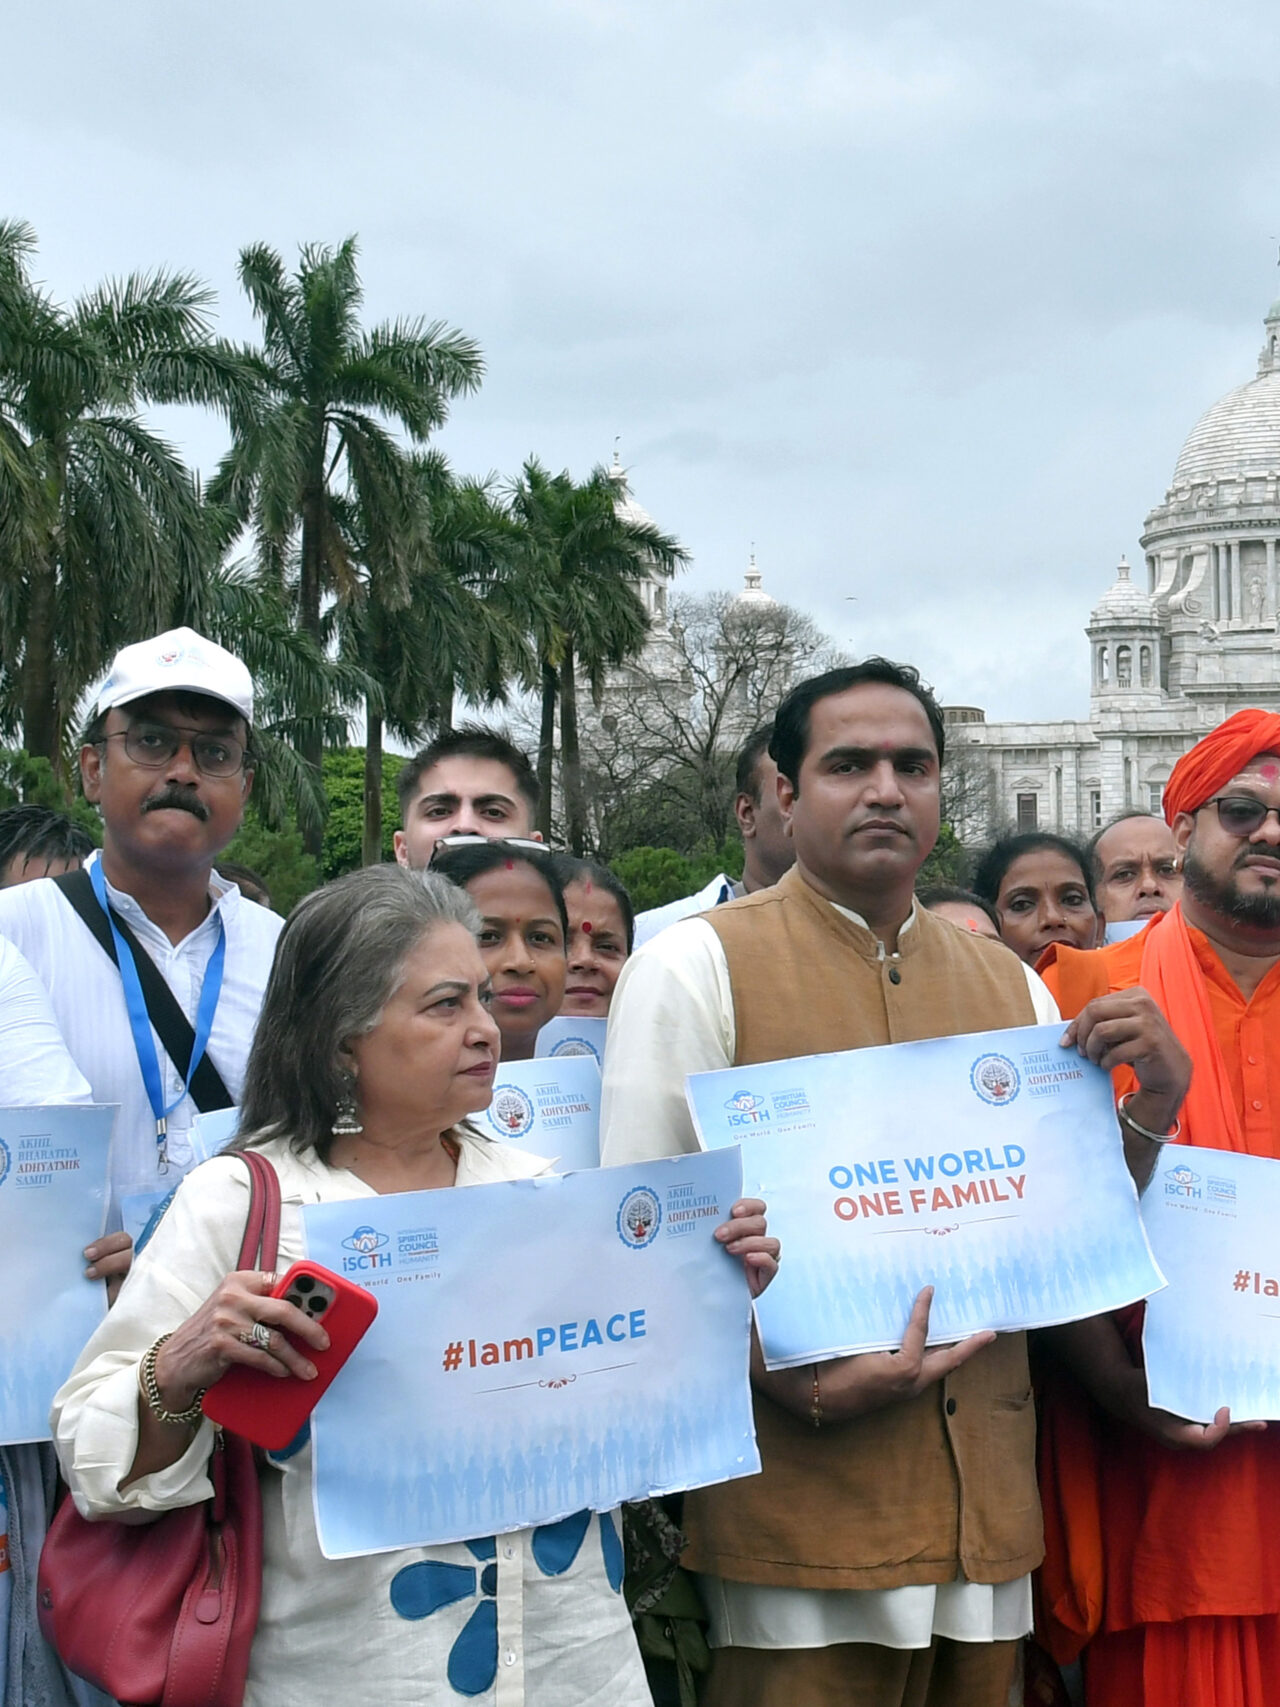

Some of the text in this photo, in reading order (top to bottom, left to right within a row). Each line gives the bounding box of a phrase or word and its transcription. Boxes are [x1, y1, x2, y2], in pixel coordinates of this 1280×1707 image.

[1022, 1053, 1052, 1065] AKHIL
[1024, 1060, 1079, 1075] BHARATIYA
[1027, 1070, 1083, 1085] ADHYATMIK
[535, 1086, 562, 1097] AKHIL
[1028, 1084, 1060, 1096] SAMITI
[537, 1094, 586, 1107] BHARATIYA
[541, 1103, 591, 1117] ADHYATMIK
[542, 1116, 572, 1127] SAMITI
[728, 1110, 770, 1127] iSCTH
[18, 1138, 51, 1149] AKHIL
[18, 1148, 78, 1161] BHARATIYA
[17, 1159, 80, 1173] ADHYATMIK
[829, 1144, 1026, 1189] ONE WORLD
[16, 1174, 52, 1186] SAMITI
[667, 1186, 694, 1199] AKHIL
[834, 1174, 1026, 1221] ONE FAMILY
[1165, 1184, 1201, 1198] iSCTH
[667, 1194, 718, 1211] BHARATIYA
[667, 1206, 720, 1223] ADHYATMIK
[667, 1221, 696, 1234] SAMITI
[398, 1232, 438, 1243] SPIRITUAL
[399, 1241, 438, 1252] COUNCIL
[342, 1252, 392, 1272] iSCTH
[364, 1278, 389, 1287] World
[415, 1272, 441, 1281] Family
[442, 1309, 647, 1372] #IamPEACE
